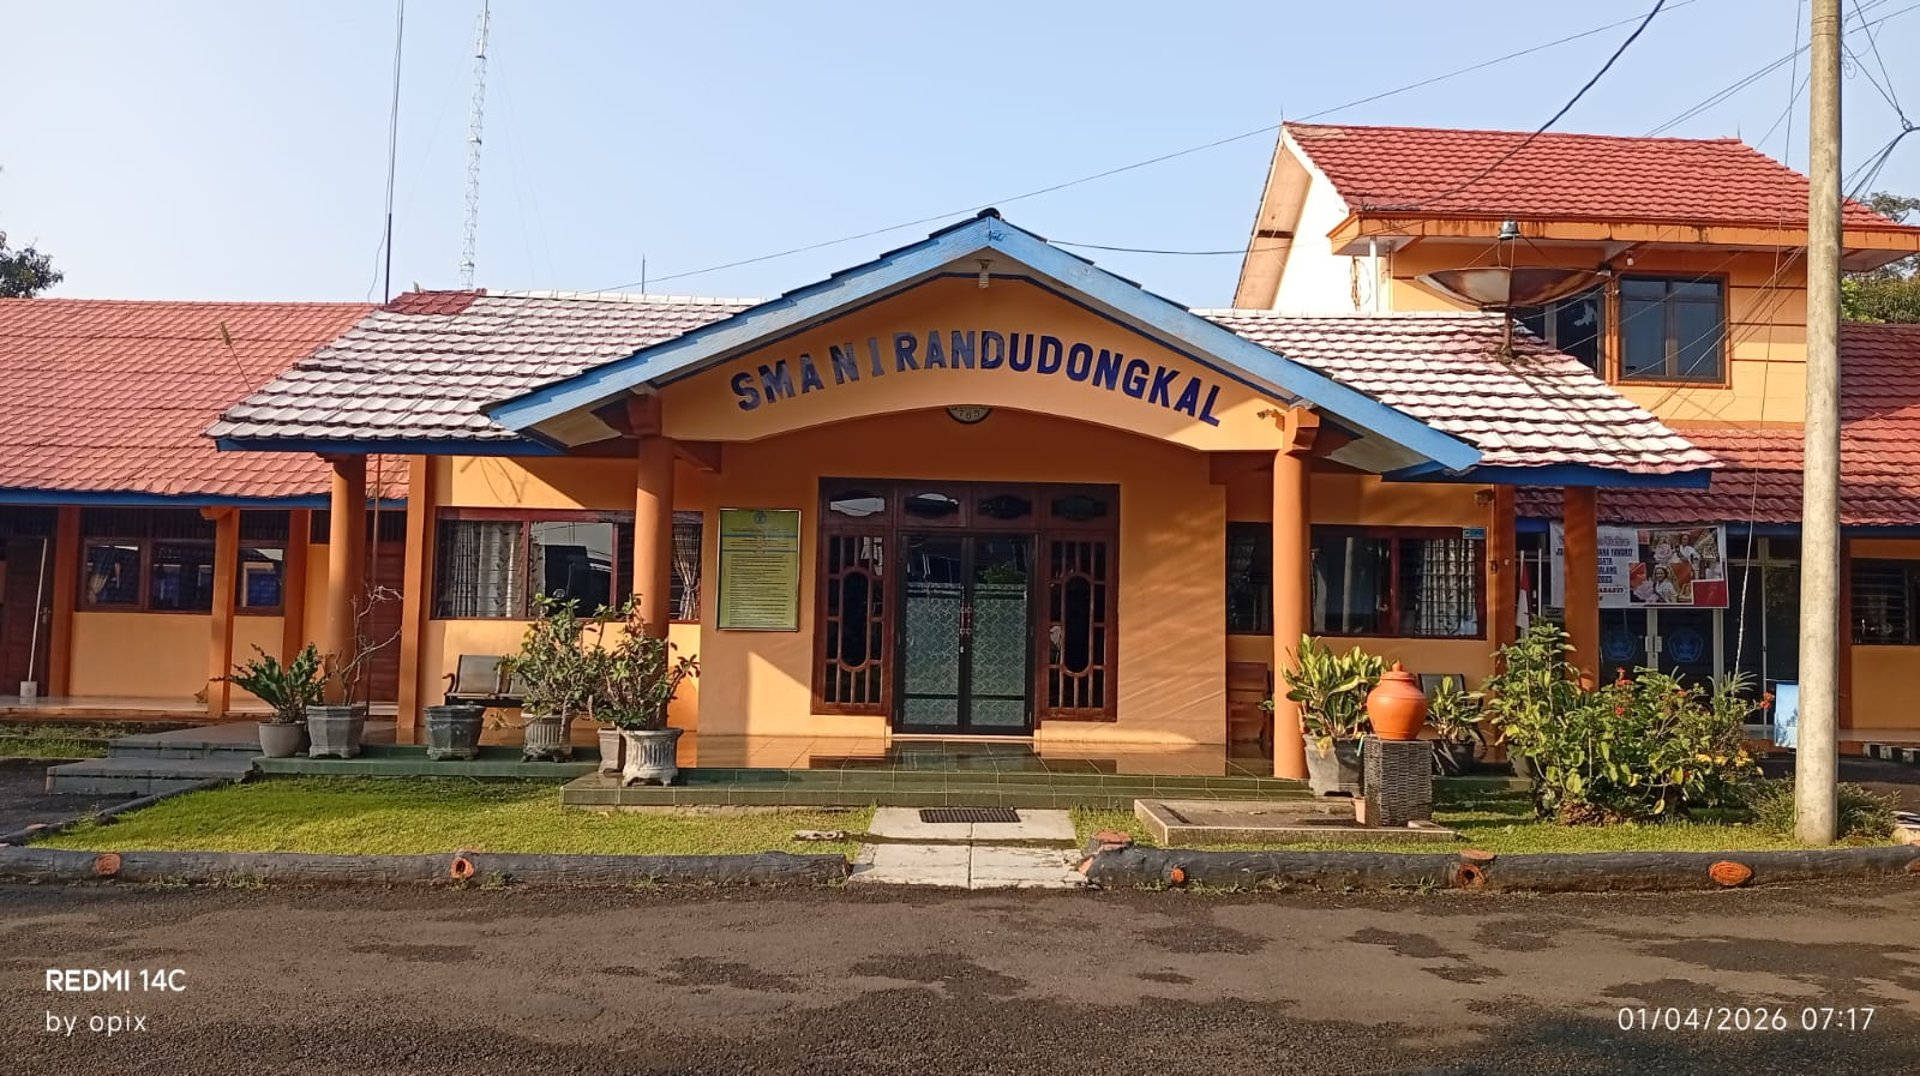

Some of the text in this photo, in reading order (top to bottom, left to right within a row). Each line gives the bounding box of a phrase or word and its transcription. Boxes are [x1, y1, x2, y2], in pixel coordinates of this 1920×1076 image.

[731, 353, 825, 410] SMA
[829, 342, 860, 384] N
[893, 329, 1221, 427] RANDUDONGKAL
